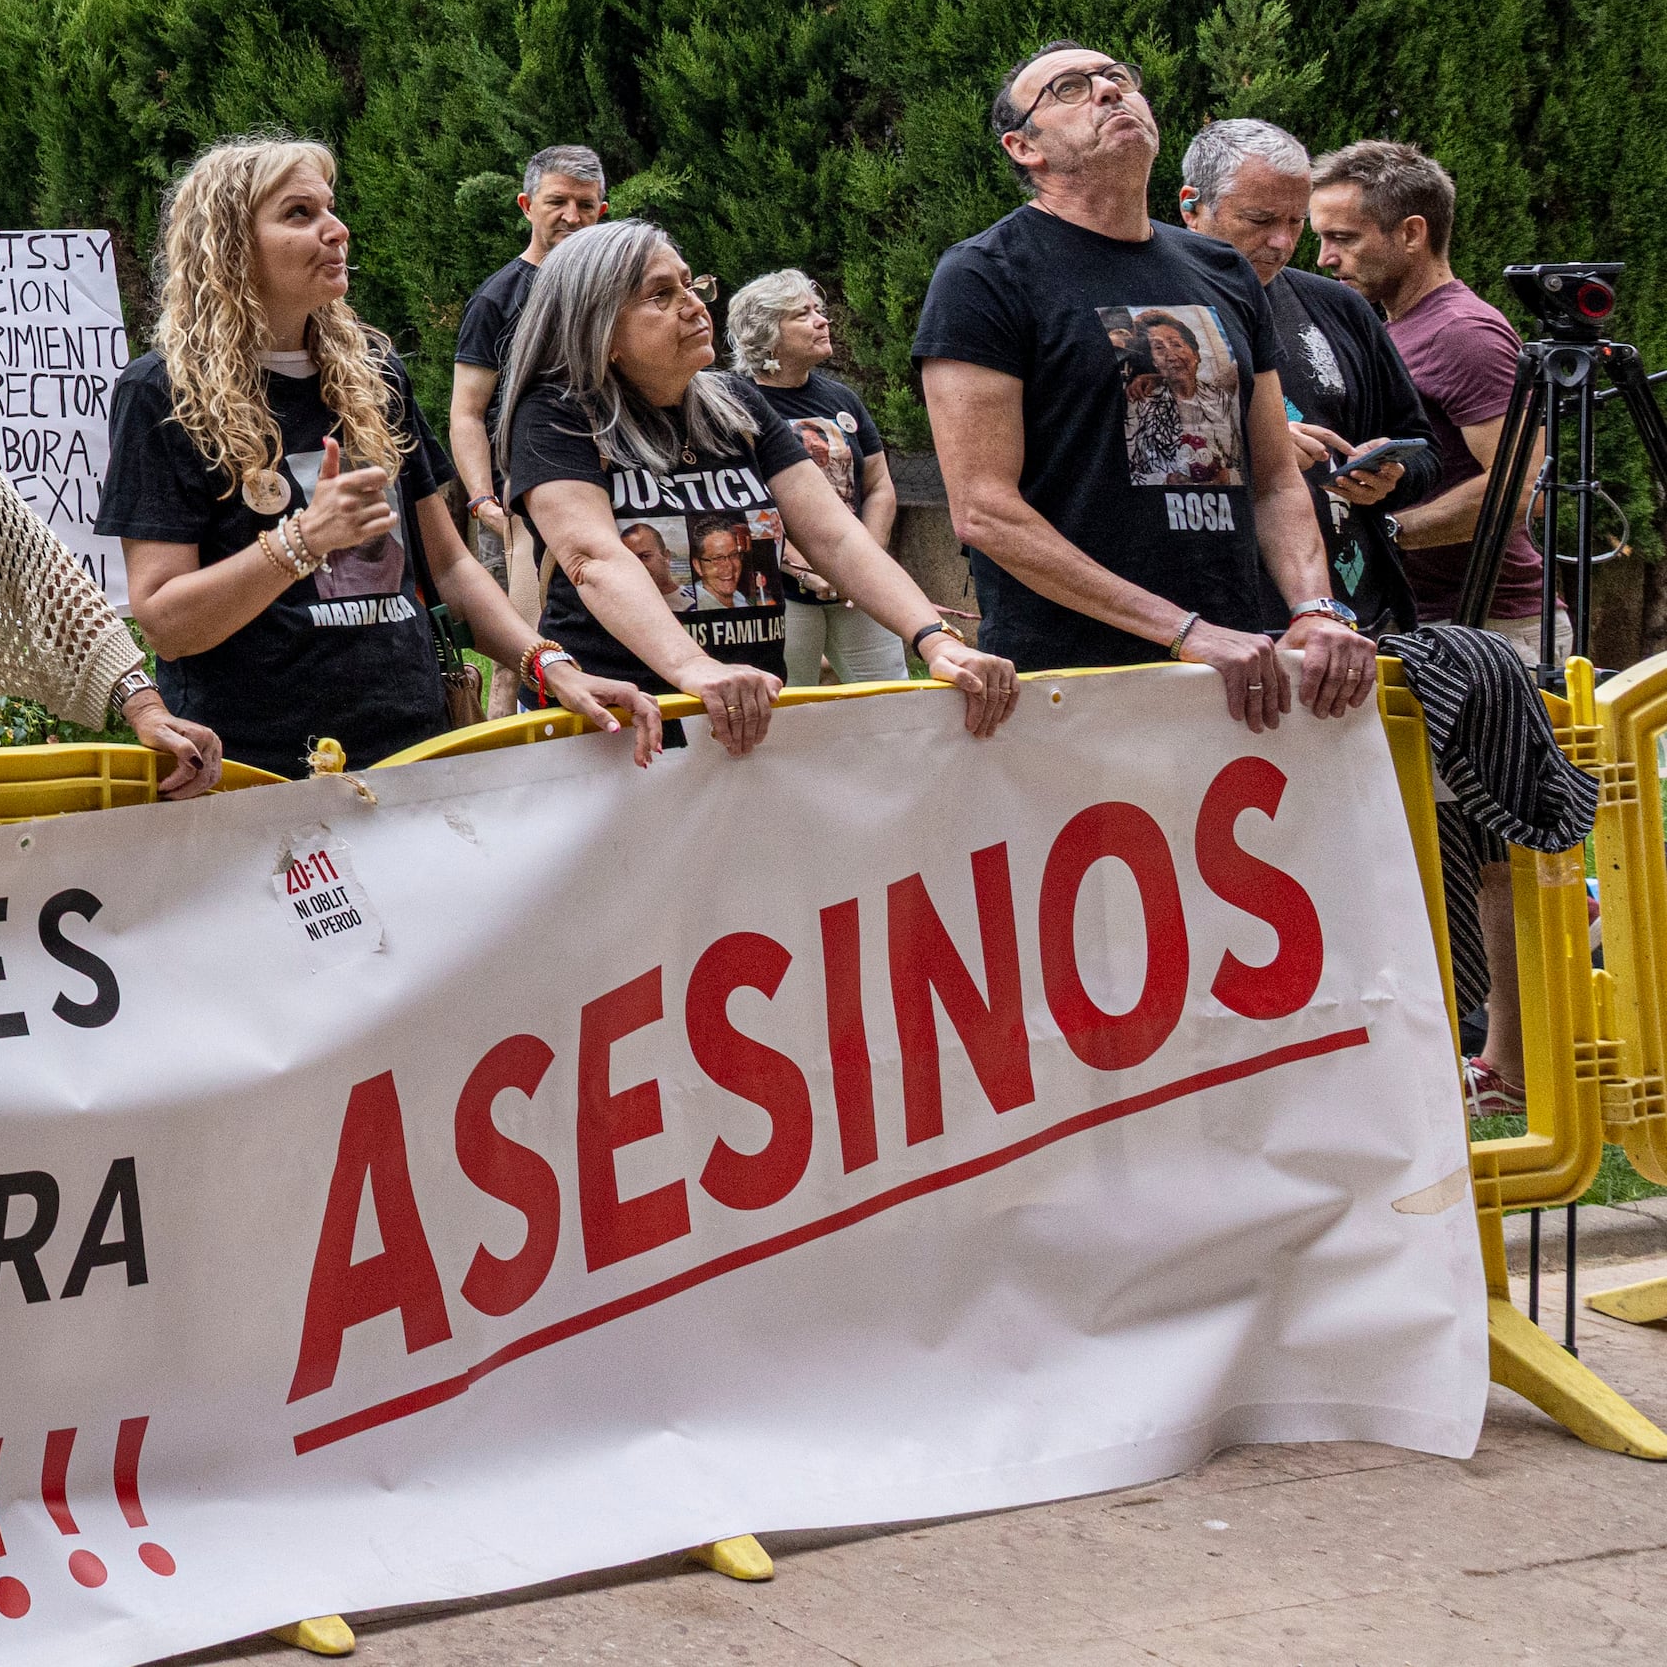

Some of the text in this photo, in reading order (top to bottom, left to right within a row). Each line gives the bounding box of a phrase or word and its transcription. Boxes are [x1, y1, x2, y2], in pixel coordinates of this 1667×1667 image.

[612, 467, 772, 510] JUSTICI
[1166, 492, 1235, 532] ROSA
[293, 885, 350, 920] NI OBLIT
[304, 905, 363, 942] NI PERDÓ
[285, 755, 1324, 1406] ASESINOS
